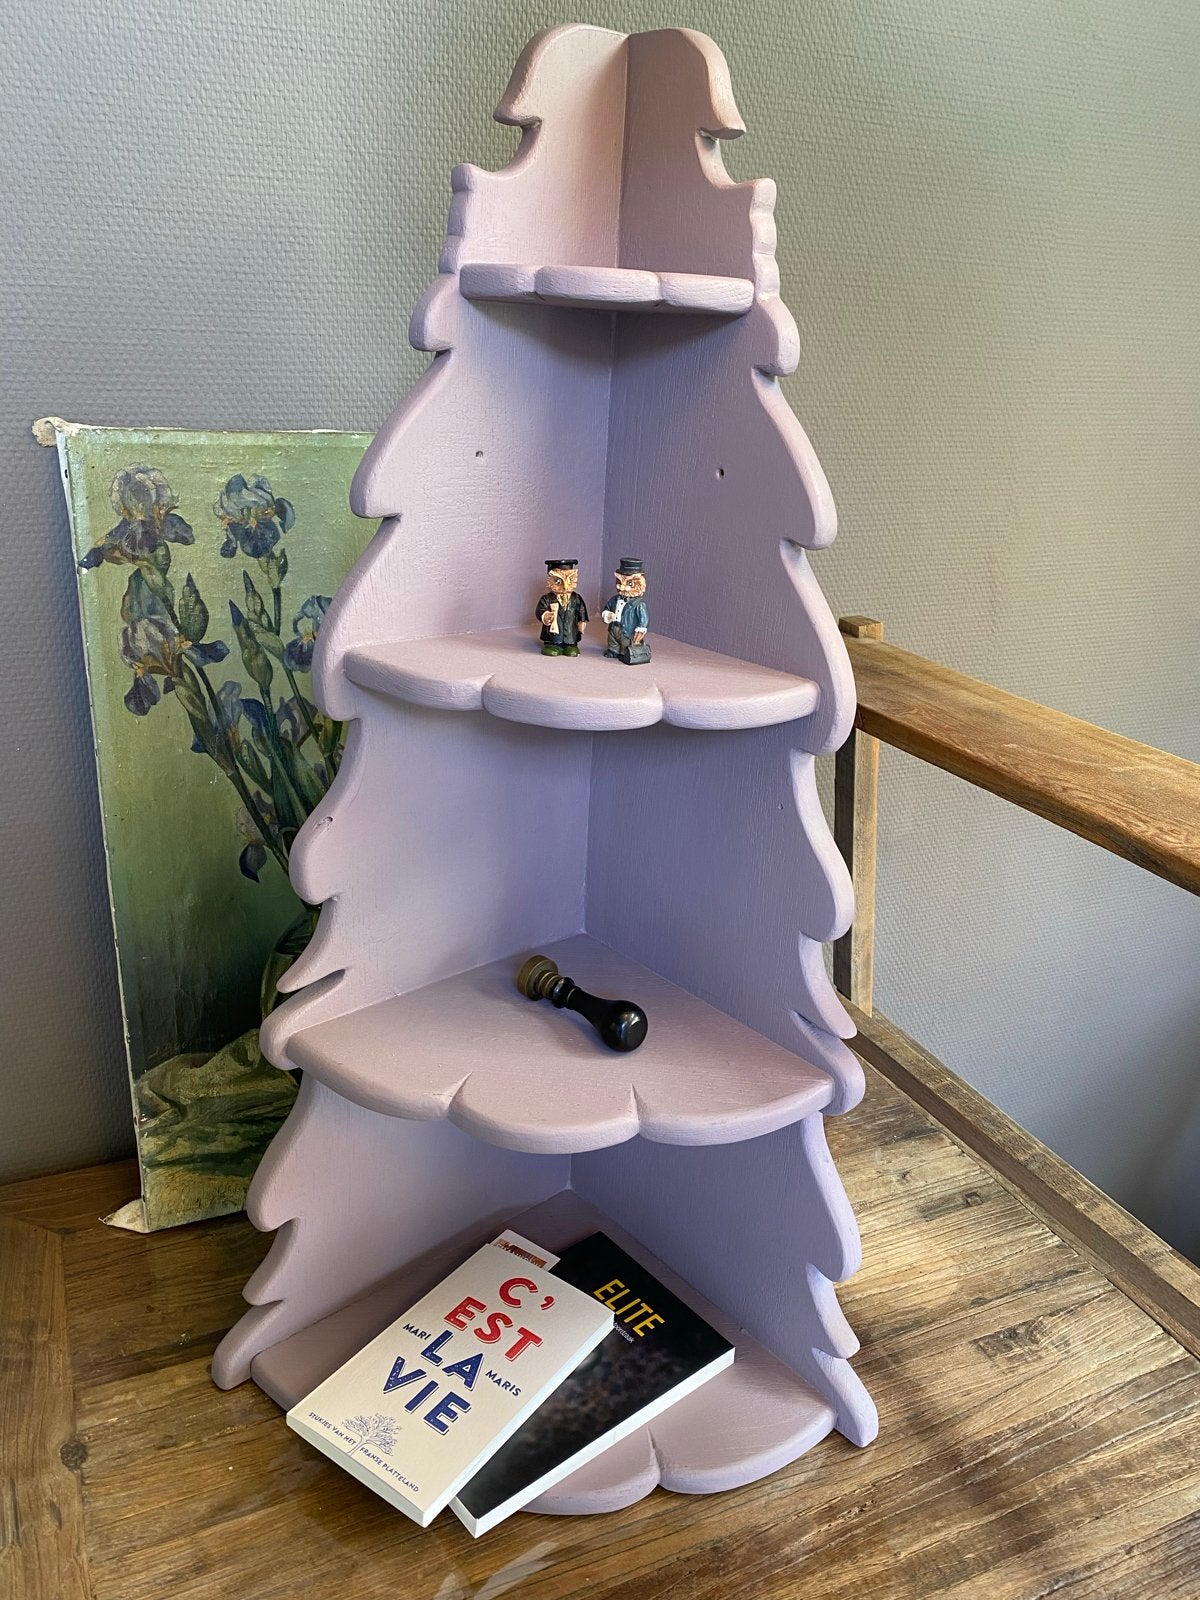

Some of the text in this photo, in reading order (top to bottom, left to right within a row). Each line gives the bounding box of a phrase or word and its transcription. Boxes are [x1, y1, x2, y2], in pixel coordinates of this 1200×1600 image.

[402, 1323, 431, 1341] MARI
[444, 1296, 543, 1362] EST
[593, 1279, 665, 1337] ELITE
[421, 1330, 484, 1391] LA
[485, 1369, 522, 1397] MARIS
[383, 1356, 472, 1436] VIE
[308, 1411, 419, 1492] STUKJES VAN HET FRANSE PLATTELAND
